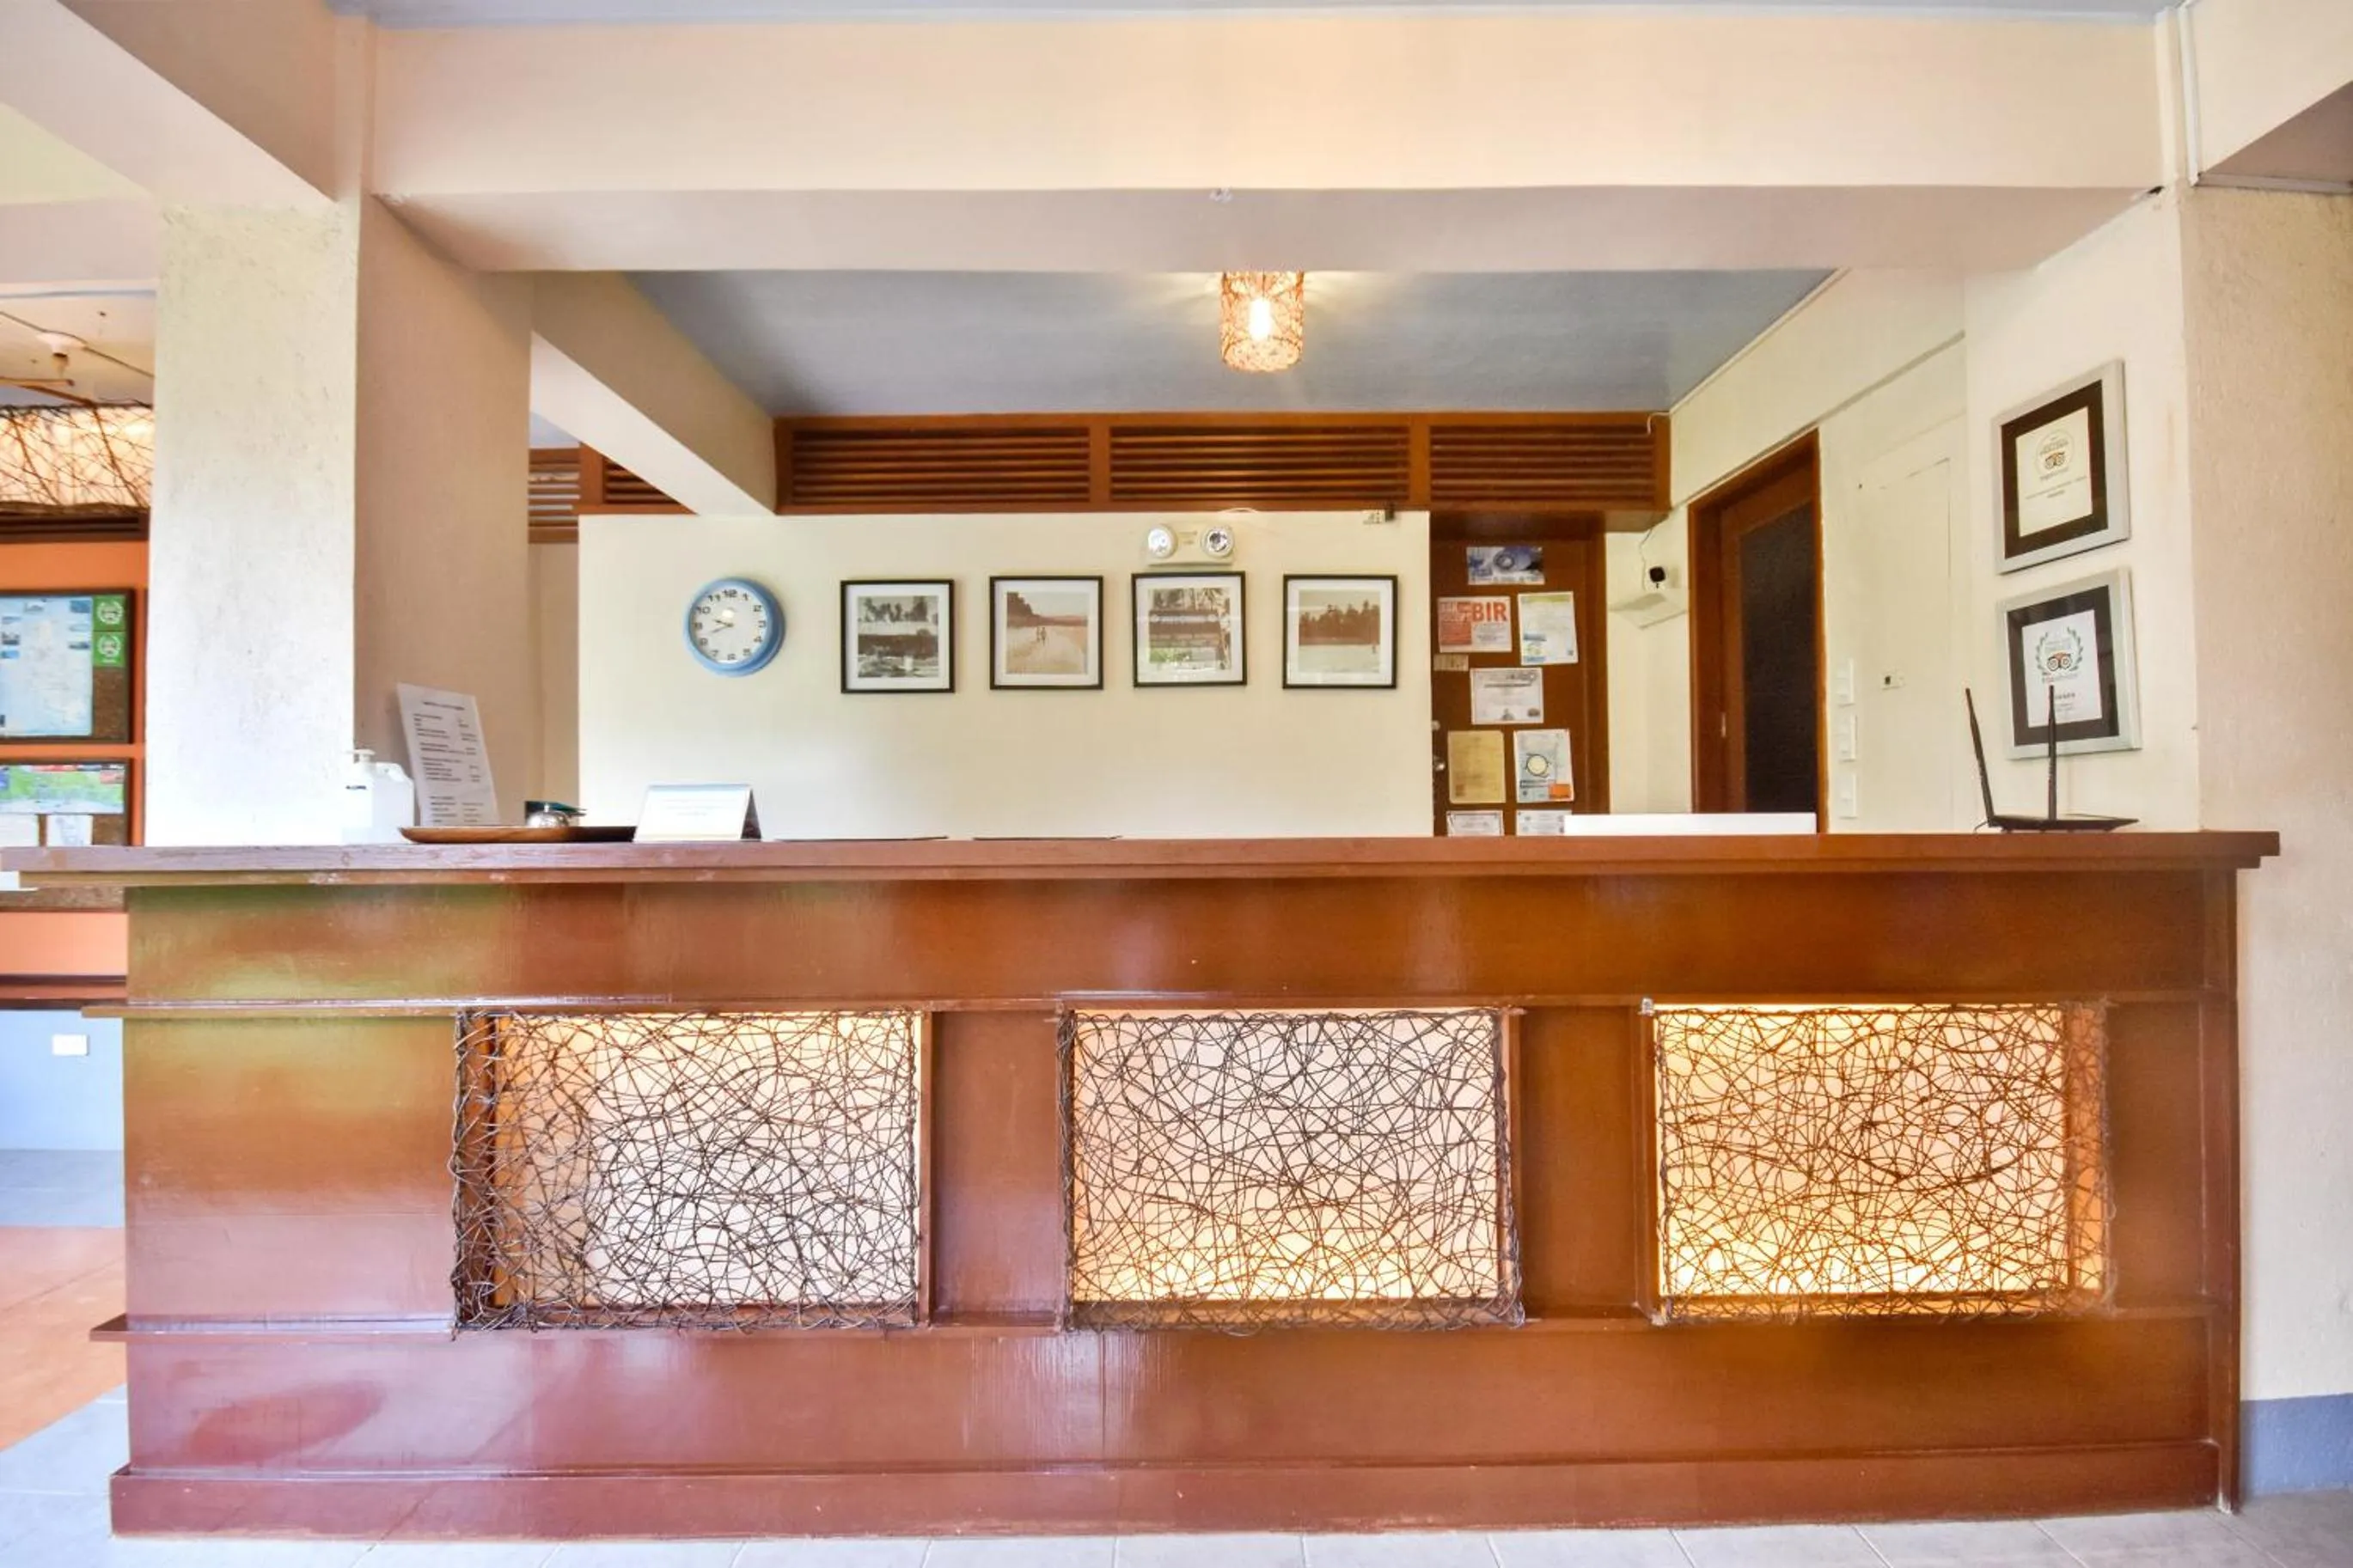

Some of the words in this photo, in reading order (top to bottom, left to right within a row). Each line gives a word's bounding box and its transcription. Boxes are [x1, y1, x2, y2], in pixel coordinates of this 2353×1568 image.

[722, 589, 737, 598] 12
[695, 606, 712, 614] 10
[1473, 602, 1507, 622] BIR
